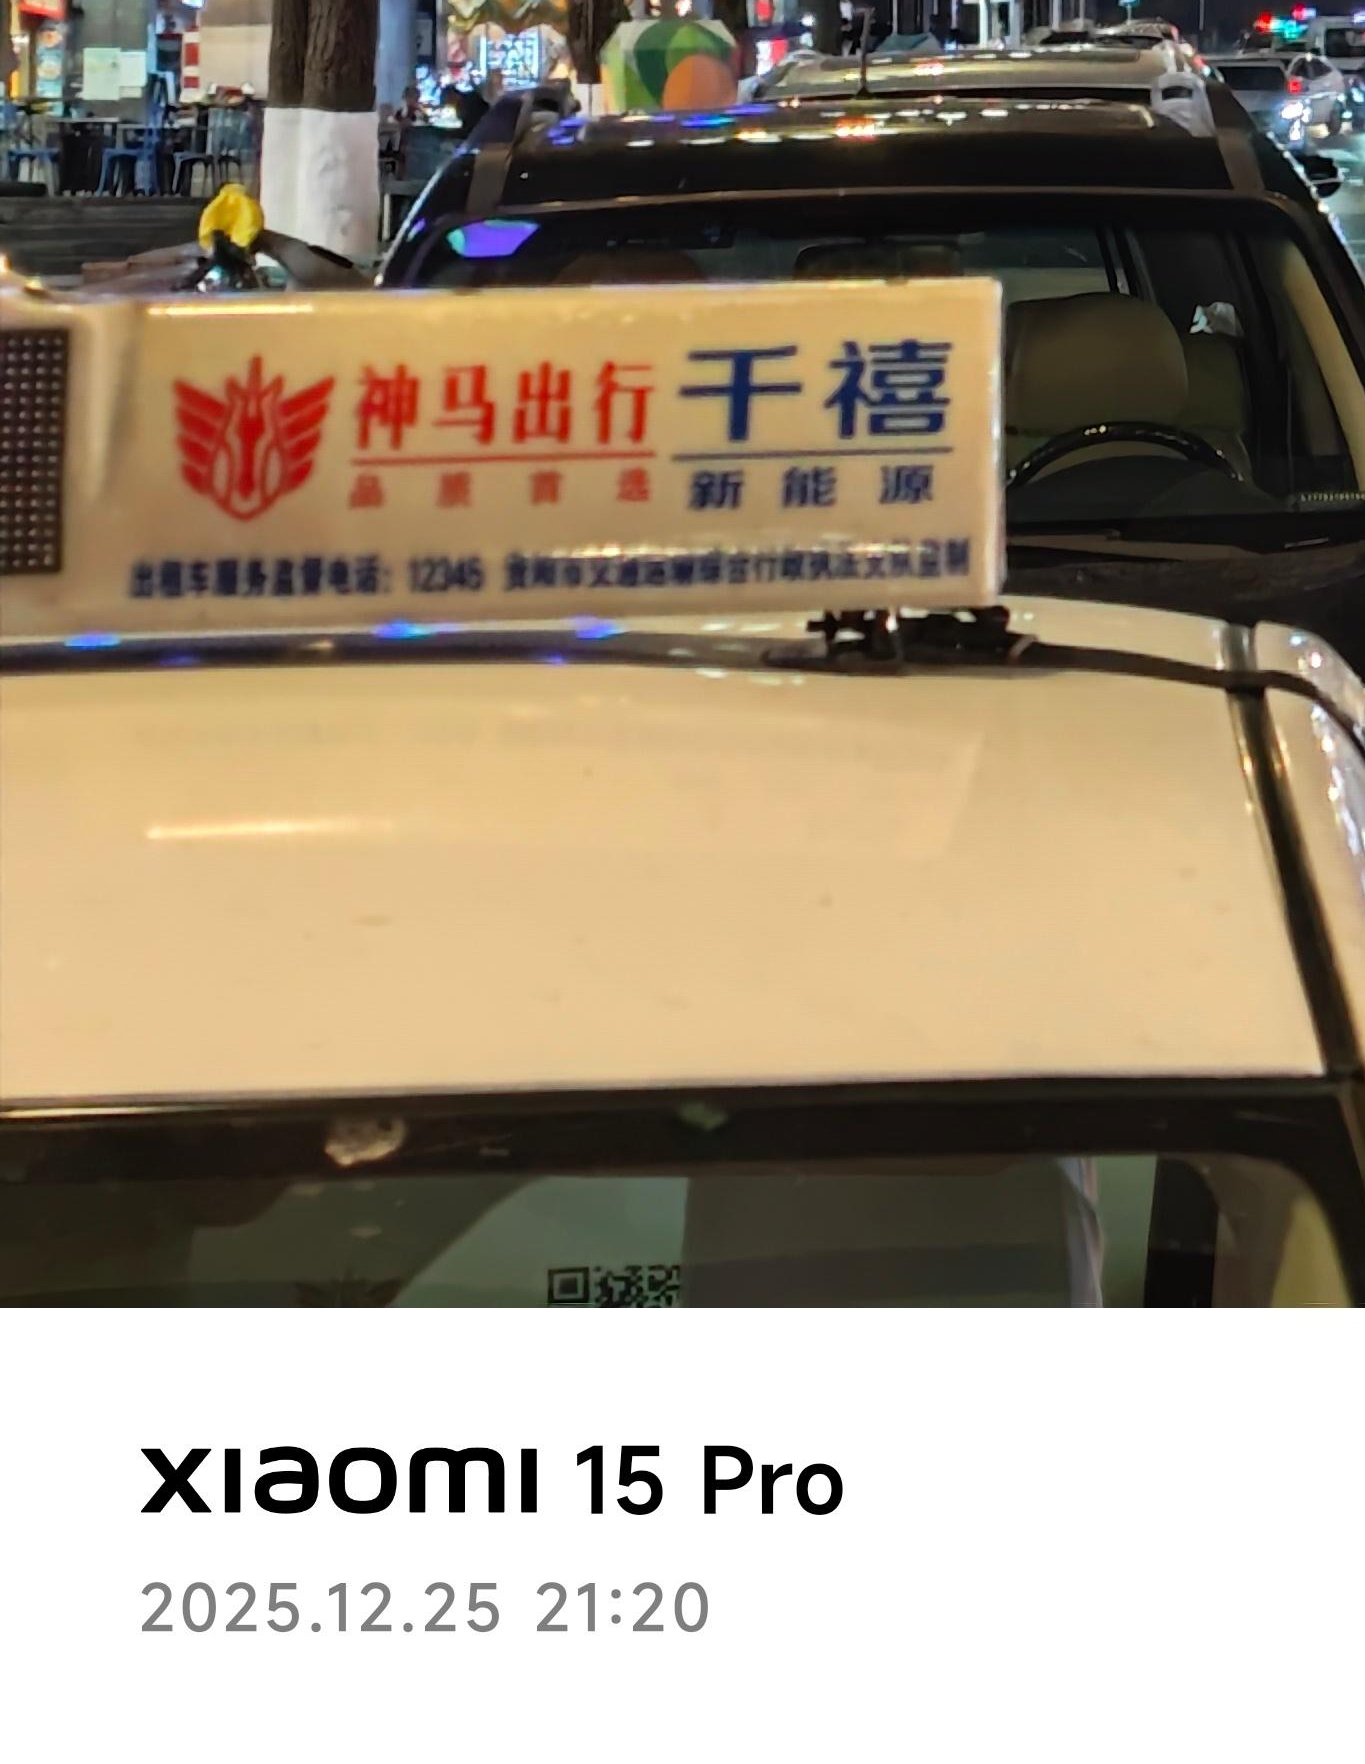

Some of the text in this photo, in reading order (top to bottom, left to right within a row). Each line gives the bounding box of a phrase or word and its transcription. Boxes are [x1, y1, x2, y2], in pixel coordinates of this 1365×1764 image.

[353, 359, 657, 451] 神马出行
[677, 338, 955, 442] 千禧
[347, 466, 656, 511] 品质首选
[686, 465, 936, 513] 新能源
[409, 554, 484, 594] 12345
